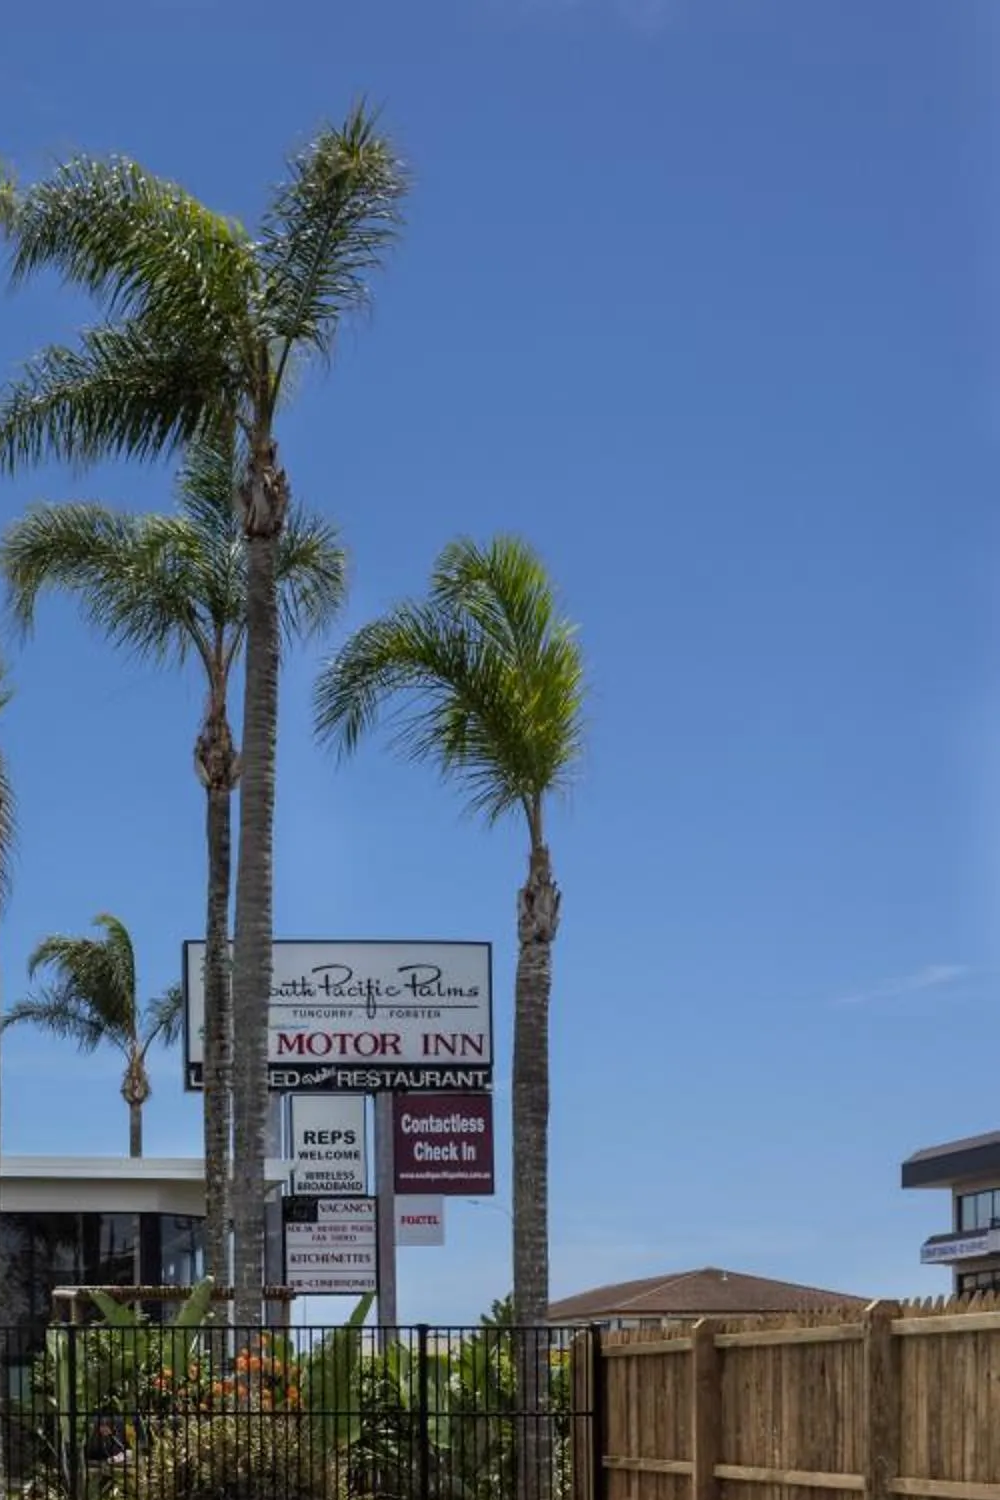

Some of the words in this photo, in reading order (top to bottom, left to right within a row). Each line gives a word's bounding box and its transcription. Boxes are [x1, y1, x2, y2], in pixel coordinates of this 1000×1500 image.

[268, 975, 317, 998] outh
[311, 963, 400, 1020] Pacific
[397, 963, 480, 998] Palms
[389, 1009, 441, 1019] FORSTER
[276, 1031, 402, 1057] MOTOR
[422, 1032, 485, 1056] INN
[401, 1113, 485, 1134] Contactless
[303, 1129, 357, 1145] REPS
[298, 1150, 361, 1161] WELCOME
[413, 1141, 460, 1161] Check
[462, 1141, 477, 1161] In
[305, 1170, 356, 1181] WIRELESS
[297, 1181, 363, 1191] BROADBAND
[319, 1203, 373, 1213] VACANCY
[290, 1253, 372, 1264] KITCHENETTES
